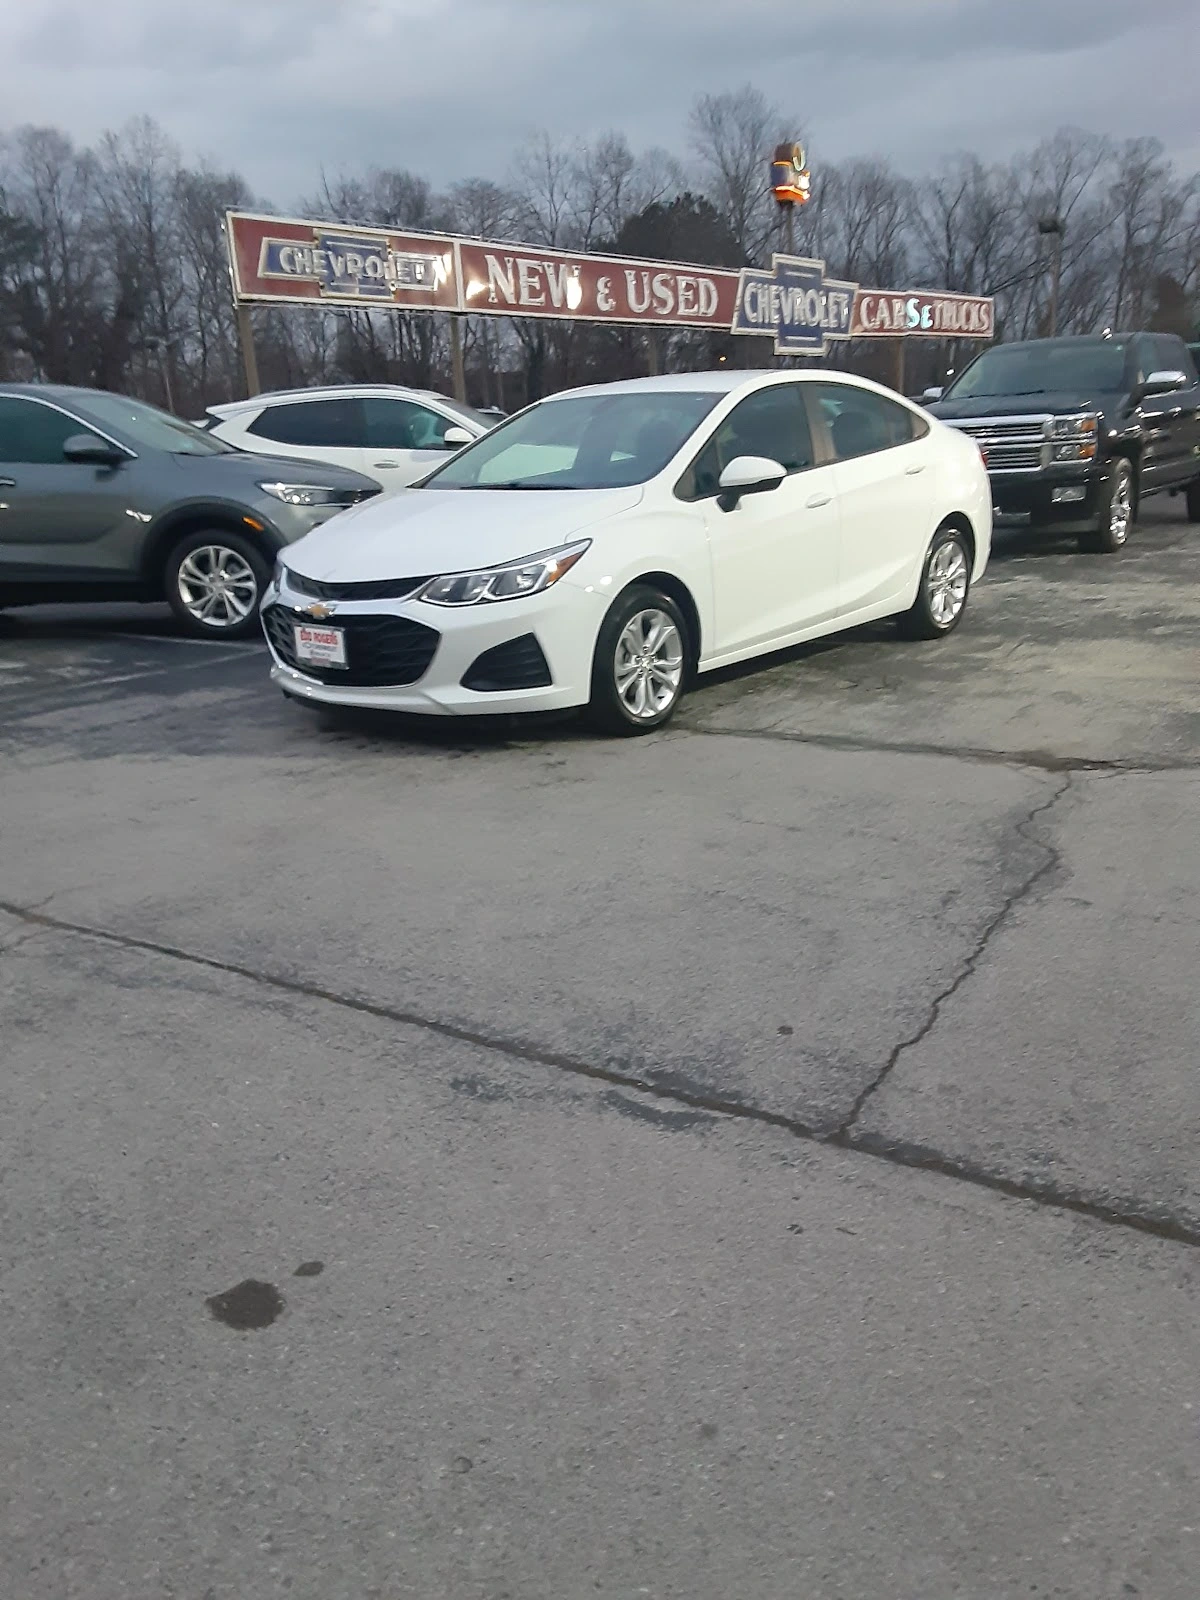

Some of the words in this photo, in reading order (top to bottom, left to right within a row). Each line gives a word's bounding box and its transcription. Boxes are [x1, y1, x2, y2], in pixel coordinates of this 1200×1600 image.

[279, 247, 426, 281] CHEVROLET
[484, 254, 582, 310] NEW
[596, 276, 616, 312] &
[624, 269, 719, 317] USED
[743, 282, 849, 328] CHEVROLET
[860, 296, 919, 330] CARS
[933, 299, 990, 332] TRUCKS
